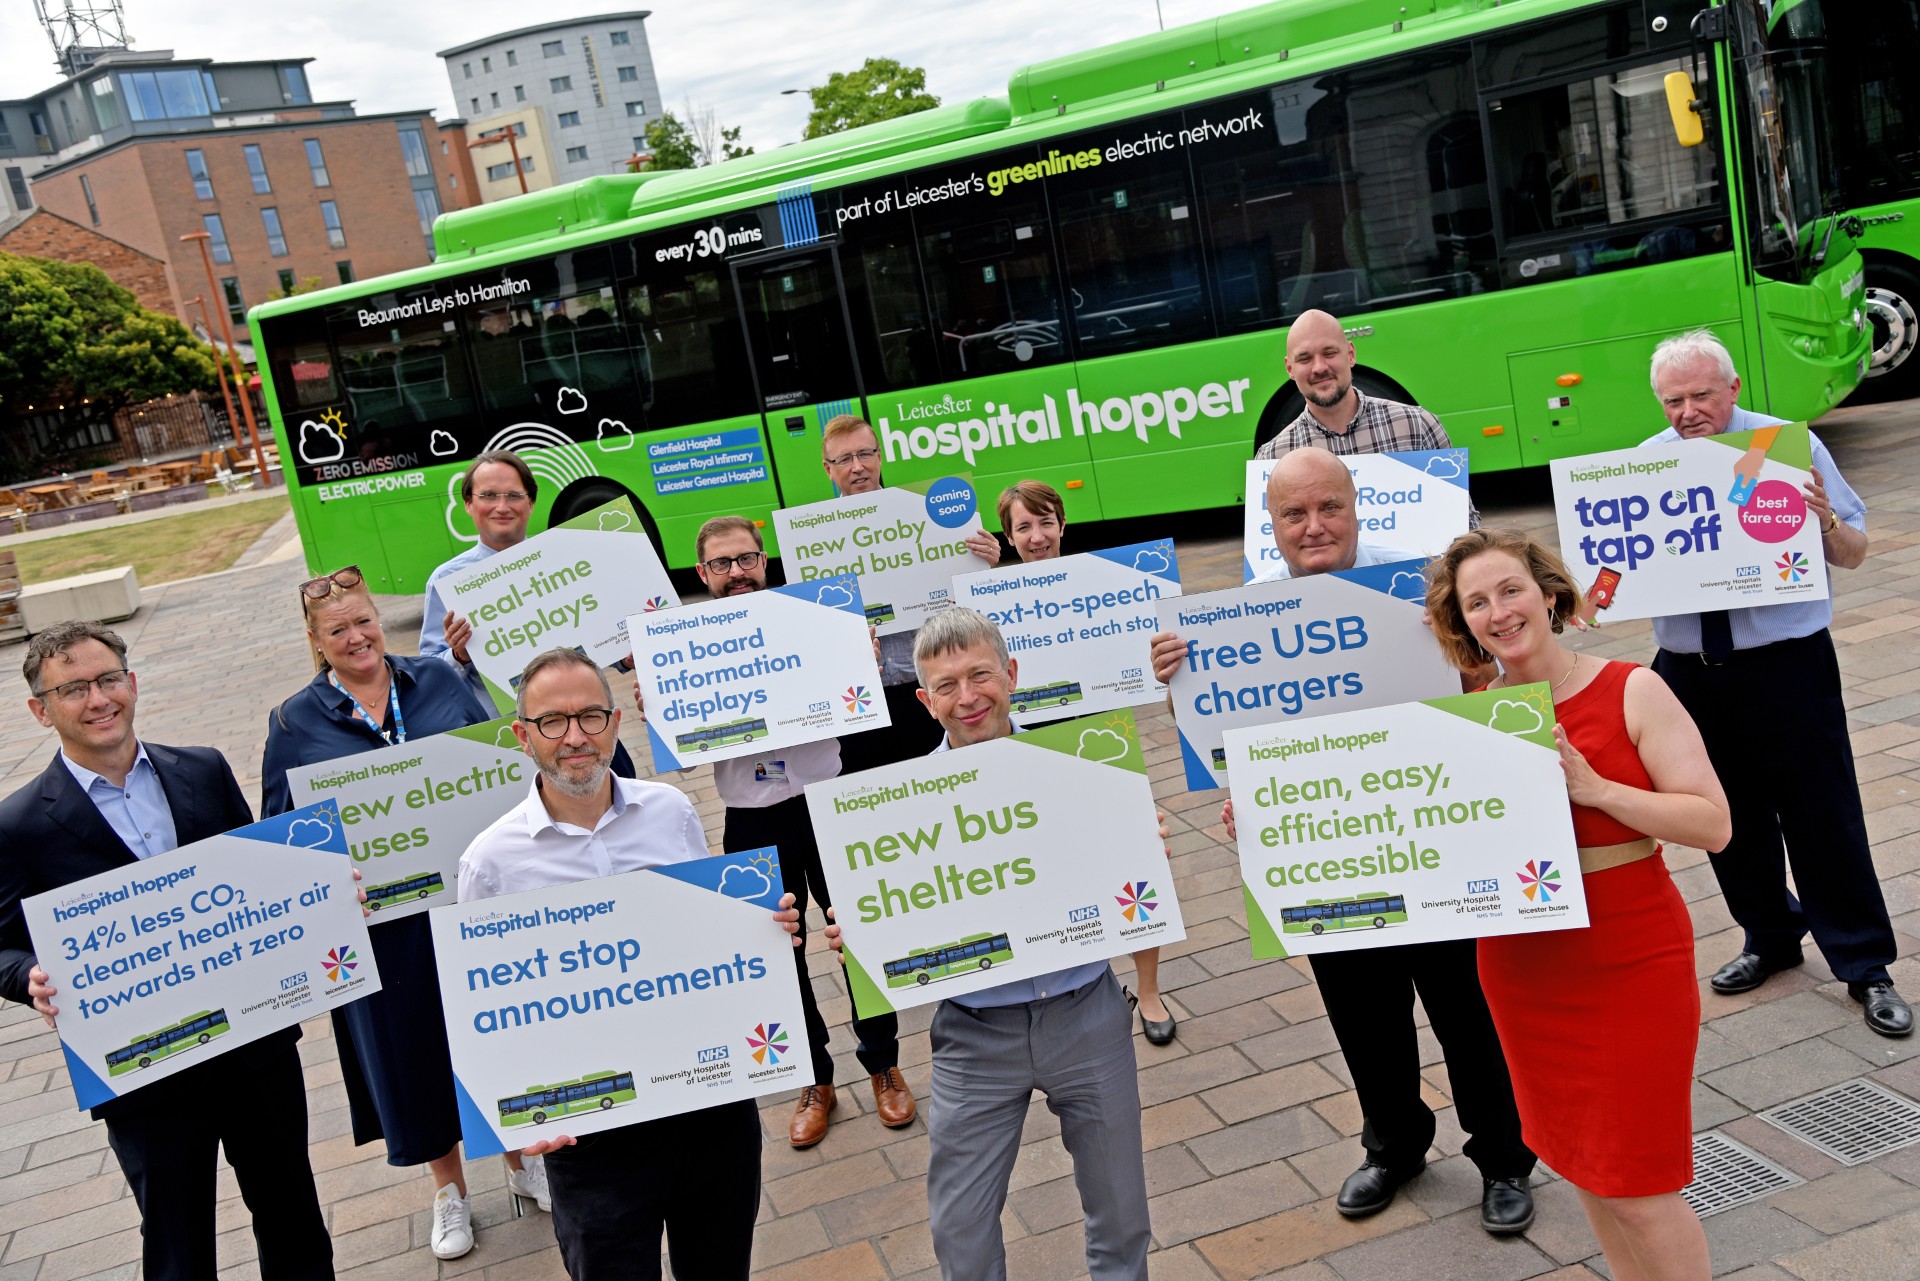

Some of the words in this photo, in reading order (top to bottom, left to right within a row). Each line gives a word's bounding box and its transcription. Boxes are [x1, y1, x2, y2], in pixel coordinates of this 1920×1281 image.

[836, 198, 870, 229] part
[874, 192, 891, 214] of
[896, 173, 984, 210] Leicester's
[987, 148, 1101, 196] greenlines
[1105, 132, 1174, 162] electric
[1179, 108, 1264, 146] network
[656, 241, 694, 262] every
[694, 226, 726, 258] 30
[728, 226, 762, 247] mins
[358, 299, 422, 327] Beaumont
[423, 293, 455, 313] Leys
[455, 290, 469, 306] to
[470, 278, 530, 302] Hamilton
[879, 394, 1062, 467] hospital
[1067, 378, 1250, 444] hopper
[897, 394, 972, 421] Leicester
[650, 439, 686, 456] Glenfield
[687, 436, 721, 451] Hospital
[313, 465, 350, 481] ZERO
[352, 453, 418, 475] EMISSION
[653, 460, 689, 474] Leicester
[690, 456, 714, 470] Royal
[716, 452, 753, 465] Infirmary
[1570, 464, 1625, 483] hospital
[1628, 458, 1679, 474] hopper
[657, 478, 693, 493] Leicester
[694, 473, 728, 486] General
[729, 467, 764, 482] Hospital
[1358, 484, 1422, 506] Road
[930, 489, 971, 504] coming
[938, 502, 966, 516] soon
[1574, 495, 1649, 532] tap
[1659, 485, 1715, 516] on
[1756, 497, 1788, 509] best
[790, 512, 836, 530] hospital
[838, 505, 878, 520] hopper
[1742, 512, 1772, 523] fare
[1775, 514, 1801, 527] cap
[796, 537, 845, 560] new
[852, 519, 926, 548] Groby
[1579, 533, 1654, 571] tap
[1664, 513, 1721, 555] off
[454, 567, 502, 595] hospital
[501, 550, 542, 574] hopper
[870, 550, 913, 573] bus
[917, 540, 967, 563] lane
[1737, 566, 1760, 577] NHS
[468, 560, 593, 628] real-time
[971, 578, 1020, 596] hospital
[1022, 573, 1067, 589] hopper
[1700, 580, 1731, 588] University
[1733, 576, 1761, 584] Hospitals
[977, 579, 1160, 627] ext-to-speech
[1178, 604, 1241, 626] hospital
[1244, 598, 1302, 616] hopper
[484, 593, 599, 657] displays
[646, 616, 699, 636] hospital
[701, 609, 749, 625] hopper
[1007, 634, 1052, 652] ilities
[1057, 628, 1074, 643] at
[1080, 620, 1121, 639] each
[652, 649, 684, 667] on
[688, 628, 765, 661] board
[1186, 640, 1262, 672] free
[1272, 616, 1368, 659] USB
[656, 654, 802, 695] information
[663, 688, 768, 722] displays
[1194, 671, 1363, 716] chargers
[1248, 736, 1320, 762] hospital
[1322, 730, 1389, 752] hopper
[310, 767, 369, 791] hospital
[371, 757, 423, 775] hopper
[1254, 776, 1352, 808] clean,
[1360, 763, 1450, 796] easy,
[340, 795, 394, 825] ew
[405, 759, 522, 809] electric
[834, 782, 909, 814] hospital
[911, 768, 979, 795] hopper
[845, 822, 943, 870] new
[954, 801, 1039, 844] bus
[1260, 804, 1404, 848] efficient,
[1413, 797, 1505, 828] more
[350, 827, 429, 862] uses
[1265, 840, 1441, 888] accessible
[53, 885, 130, 923] hospital
[131, 865, 197, 895] hopper
[857, 857, 1036, 923] shelters
[1422, 899, 1461, 909] University
[1464, 894, 1500, 904] Hospitals
[1467, 879, 1498, 894] NHS
[460, 908, 541, 940] hospital
[545, 900, 616, 925] hopper
[1069, 905, 1100, 923] NHS
[1467, 903, 1501, 913] Leicester
[62, 921, 126, 960] 34%
[131, 906, 185, 938] less
[72, 941, 172, 990] cleaner
[178, 900, 292, 951] healthier
[300, 882, 331, 907] air
[1026, 930, 1064, 944] University
[1067, 920, 1101, 934] Hospitals
[1060, 935, 1068, 944] of
[1070, 929, 1104, 942] Leicester
[1120, 926, 1146, 936] leicester
[1148, 921, 1166, 929] buses
[79, 962, 196, 1019] towards
[202, 942, 243, 976] net
[250, 925, 305, 956] zero
[467, 948, 549, 991] next
[559, 938, 641, 973] stop
[280, 972, 308, 990] NHS
[325, 984, 348, 996] leicester
[473, 953, 767, 1034] announcements
[242, 997, 277, 1014] University
[278, 985, 309, 1000] Hospitals
[272, 1002, 280, 1010] of
[282, 991, 311, 1007] Leicester
[698, 1045, 729, 1063] NHS
[651, 1070, 691, 1083] University
[694, 1061, 730, 1074] Hospitals
[686, 1077, 694, 1085] of
[697, 1070, 732, 1083] Leicester
[748, 1069, 775, 1079] leicester
[777, 1065, 796, 1073] buses
